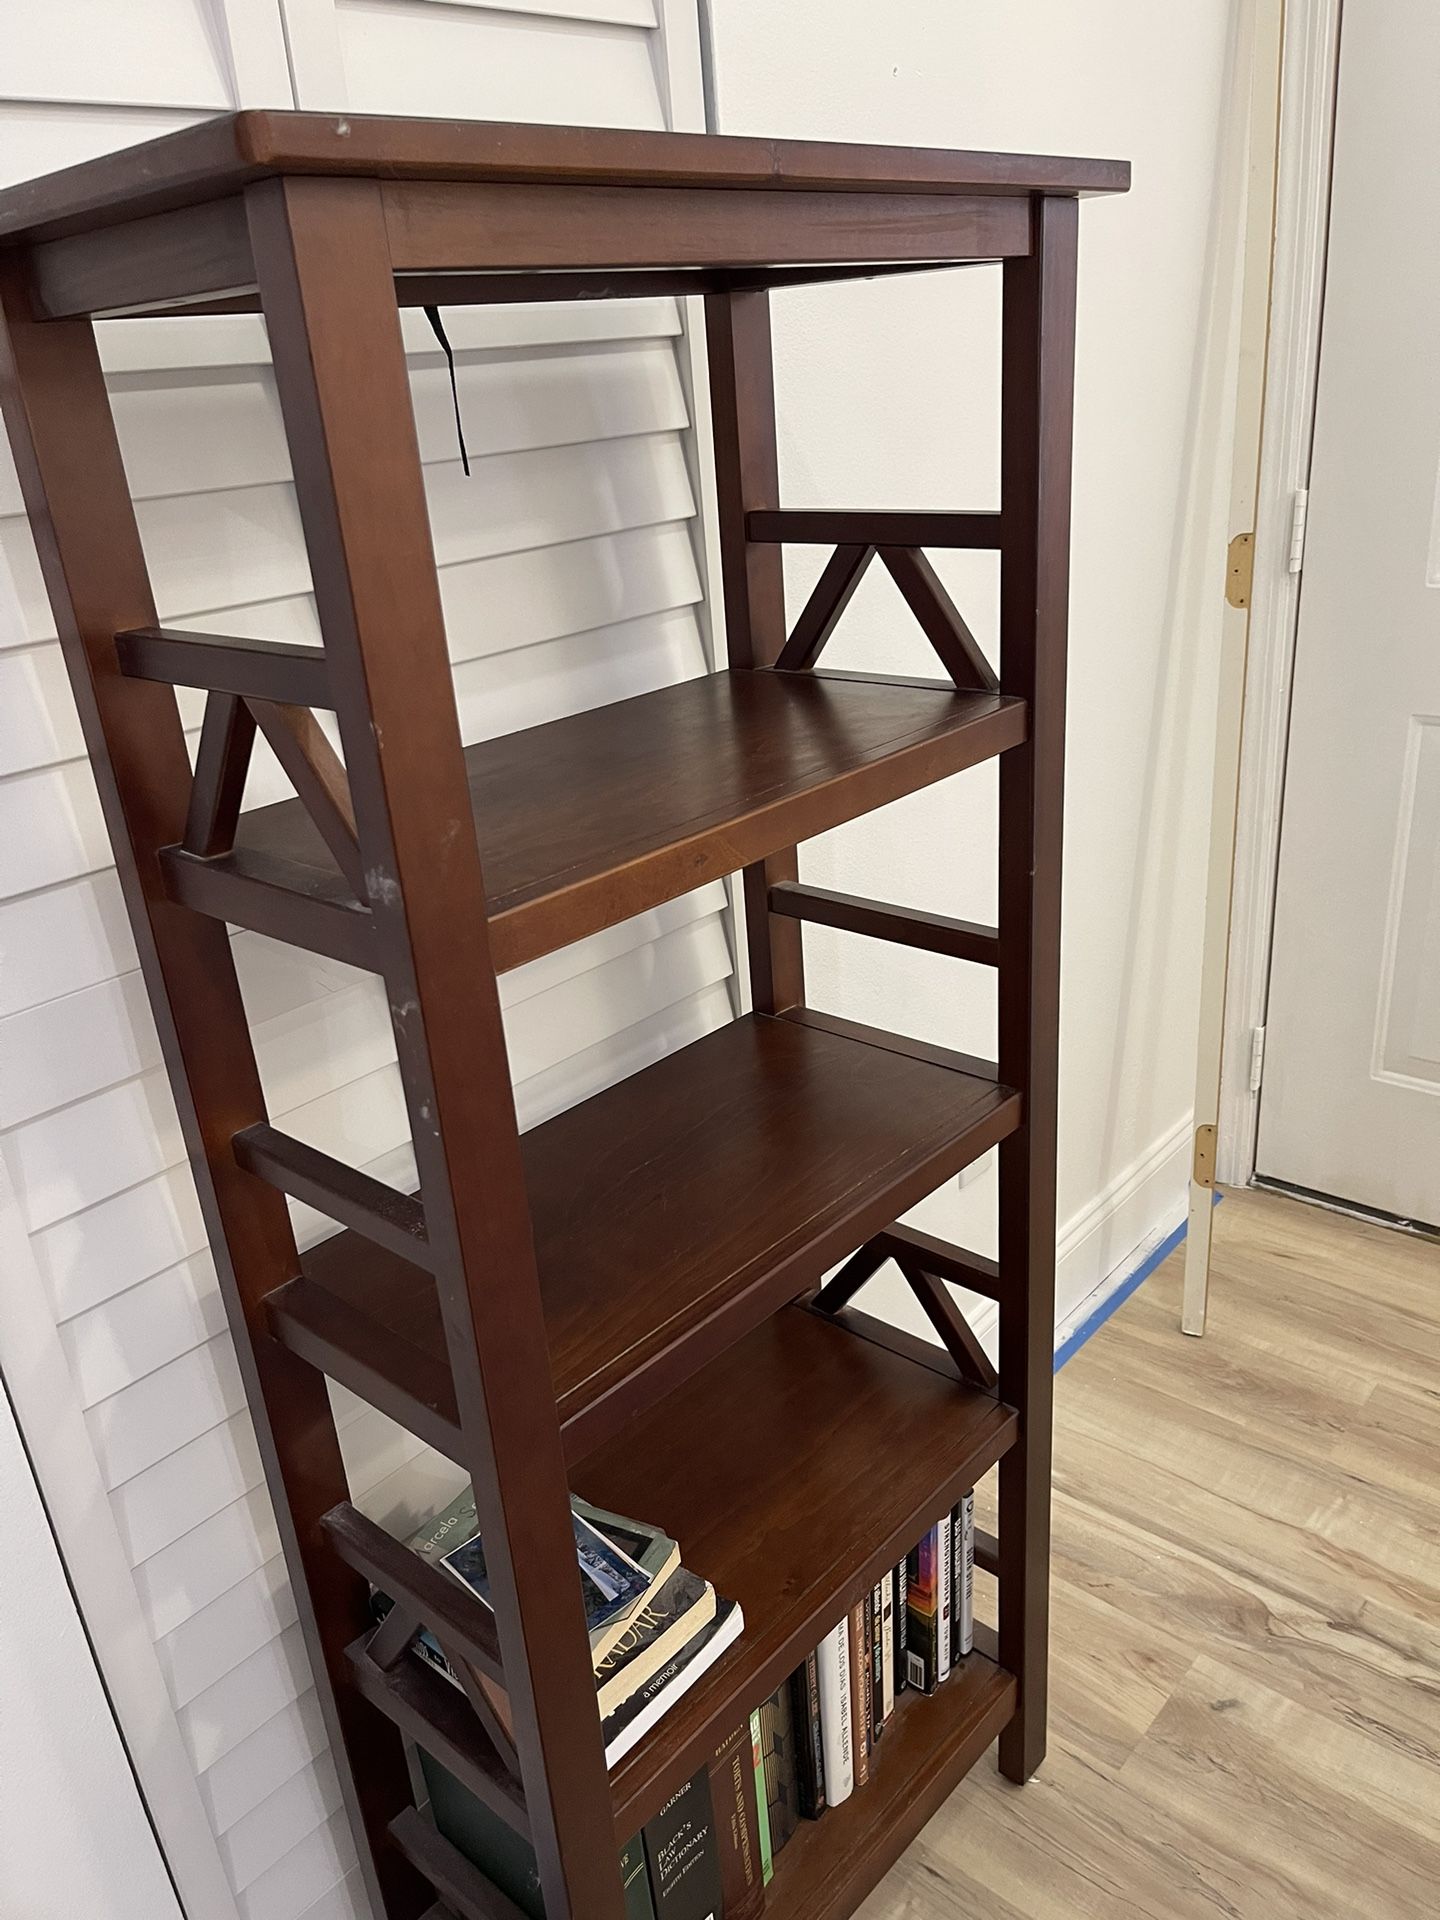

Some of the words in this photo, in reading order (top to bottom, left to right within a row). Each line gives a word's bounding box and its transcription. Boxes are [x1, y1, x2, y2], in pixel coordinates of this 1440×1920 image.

[838, 1650, 846, 1669] LOS
[649, 1663, 679, 1693] memoir
[840, 1693, 848, 1726] ISABEL
[841, 1725, 850, 1766] ALLENDE
[732, 1754, 742, 1791] TORTS
[660, 1782, 692, 1816] GARNER
[735, 1788, 745, 1813] AND
[658, 1821, 692, 1862] BLACK'S
[660, 1826, 708, 1881] DICTIONARY
[659, 1846, 677, 1871] LAW
